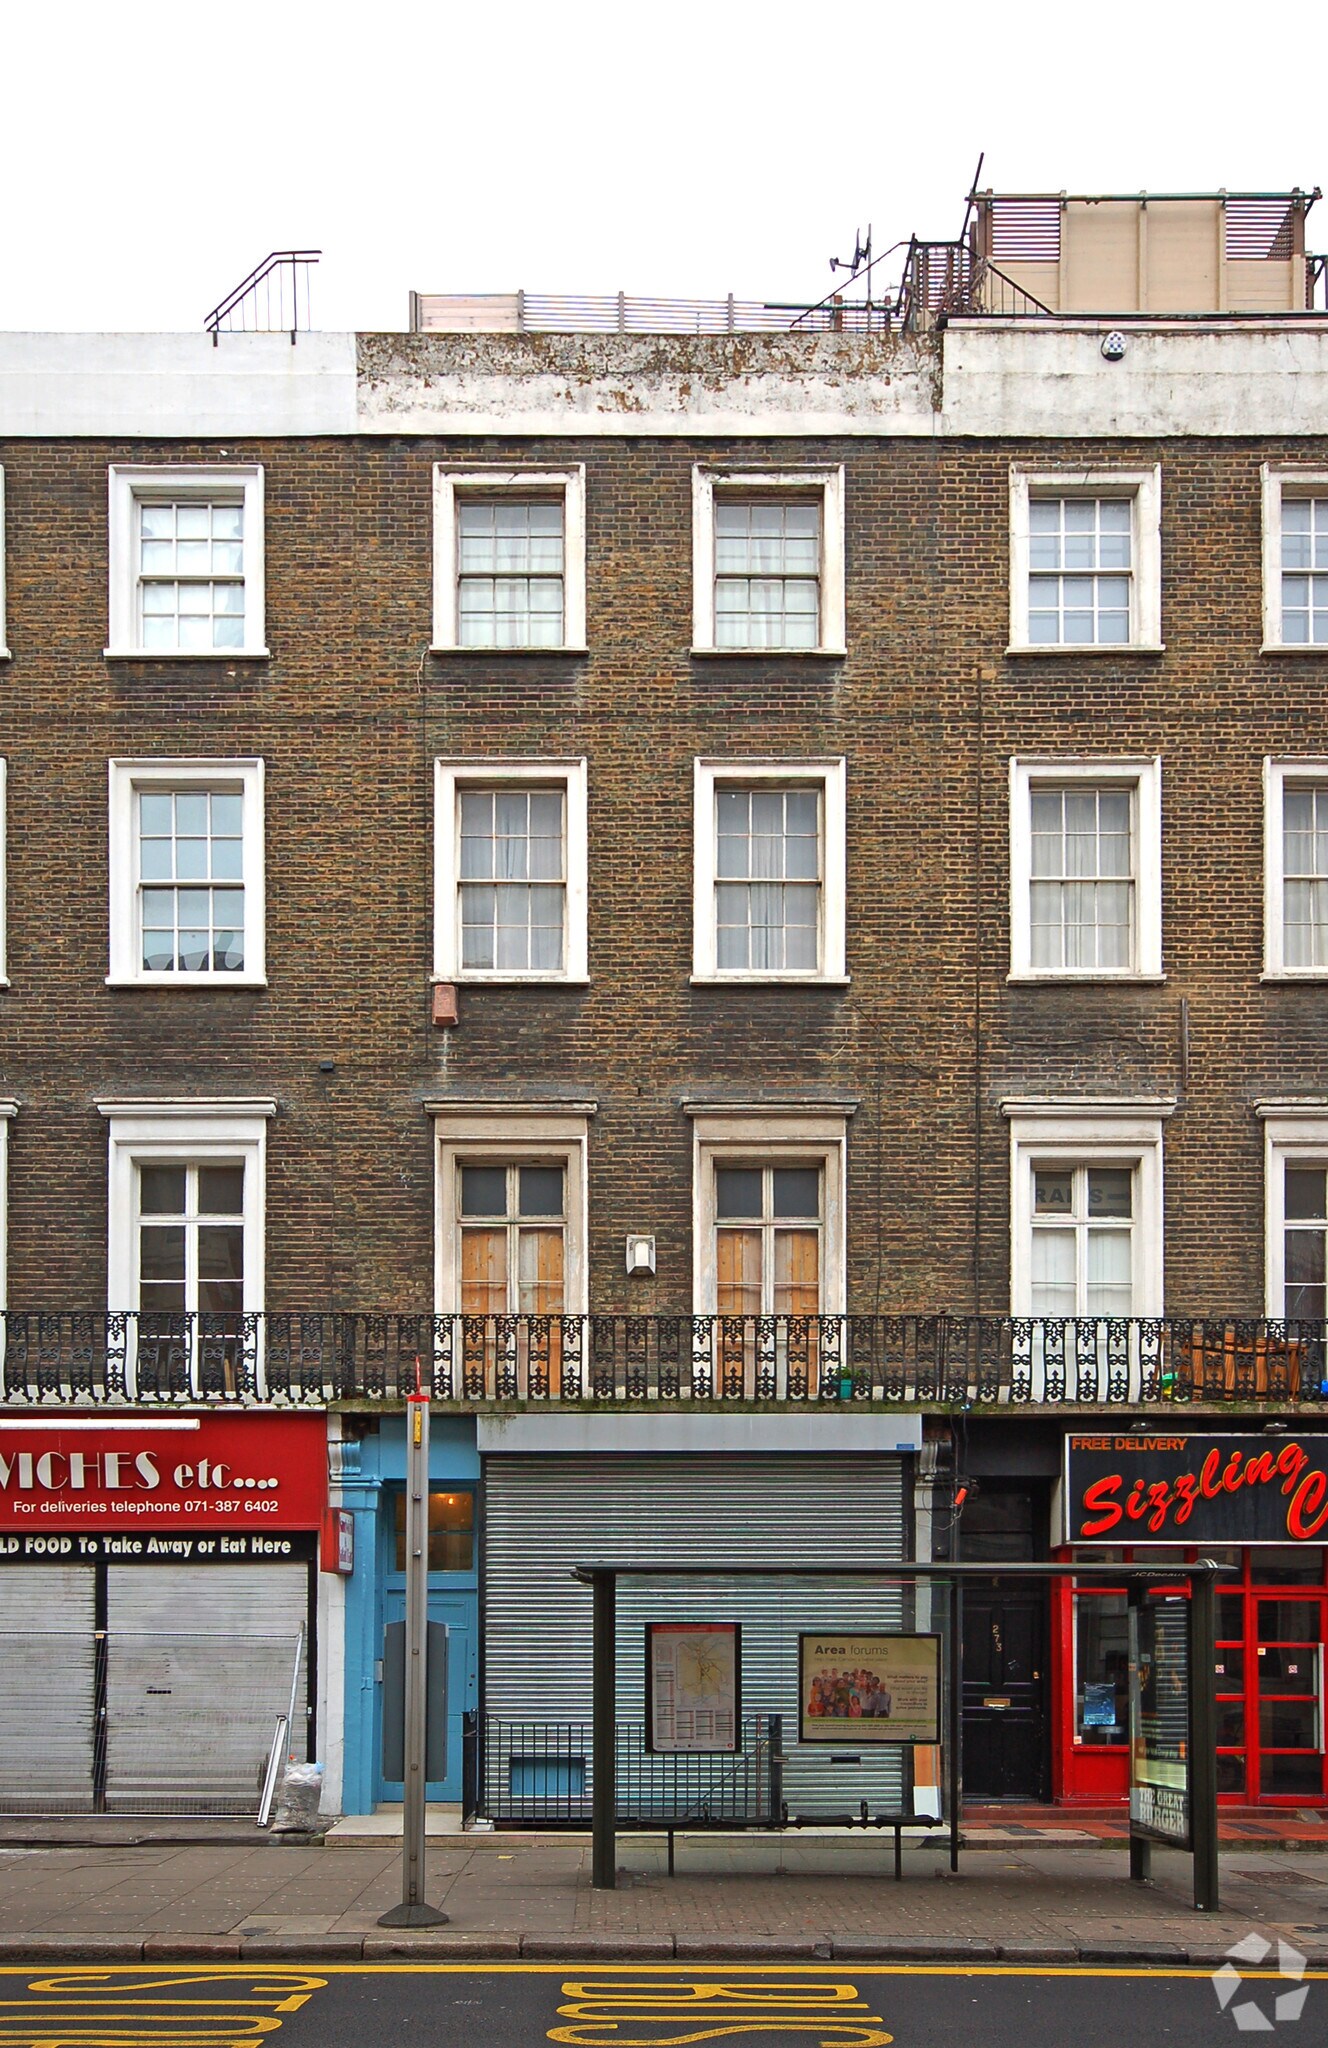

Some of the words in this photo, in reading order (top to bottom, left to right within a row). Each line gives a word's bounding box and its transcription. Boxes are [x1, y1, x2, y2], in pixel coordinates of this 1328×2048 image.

[1071, 1437, 1112, 1451] FREE
[1114, 1437, 1188, 1451] DELIVERY
[1080, 1442, 1309, 1537] Sizzling
[13, 1501, 37, 1513] For
[40, 1500, 108, 1513] deliveries
[110, 1500, 181, 1515] telephone
[184, 1500, 241, 1512] 071-387
[244, 1500, 279, 1512] 6402
[25, 1537, 72, 1554] FOOD
[78, 1537, 98, 1554] To
[102, 1536, 143, 1554] Take
[146, 1537, 193, 1558] Away
[197, 1541, 216, 1554] or
[220, 1537, 247, 1554] Eat
[251, 1536, 291, 1554] Here
[814, 1645, 846, 1655] Area
[850, 1644, 889, 1656] forums
[992, 1624, 1003, 1652] 273
[1138, 1786, 1156, 1805] THE
[1156, 1790, 1185, 1811] GREAT
[1138, 1802, 1185, 1834] BURGER
[0, 1974, 329, 2048] STO
[546, 1982, 894, 2048] BUS
